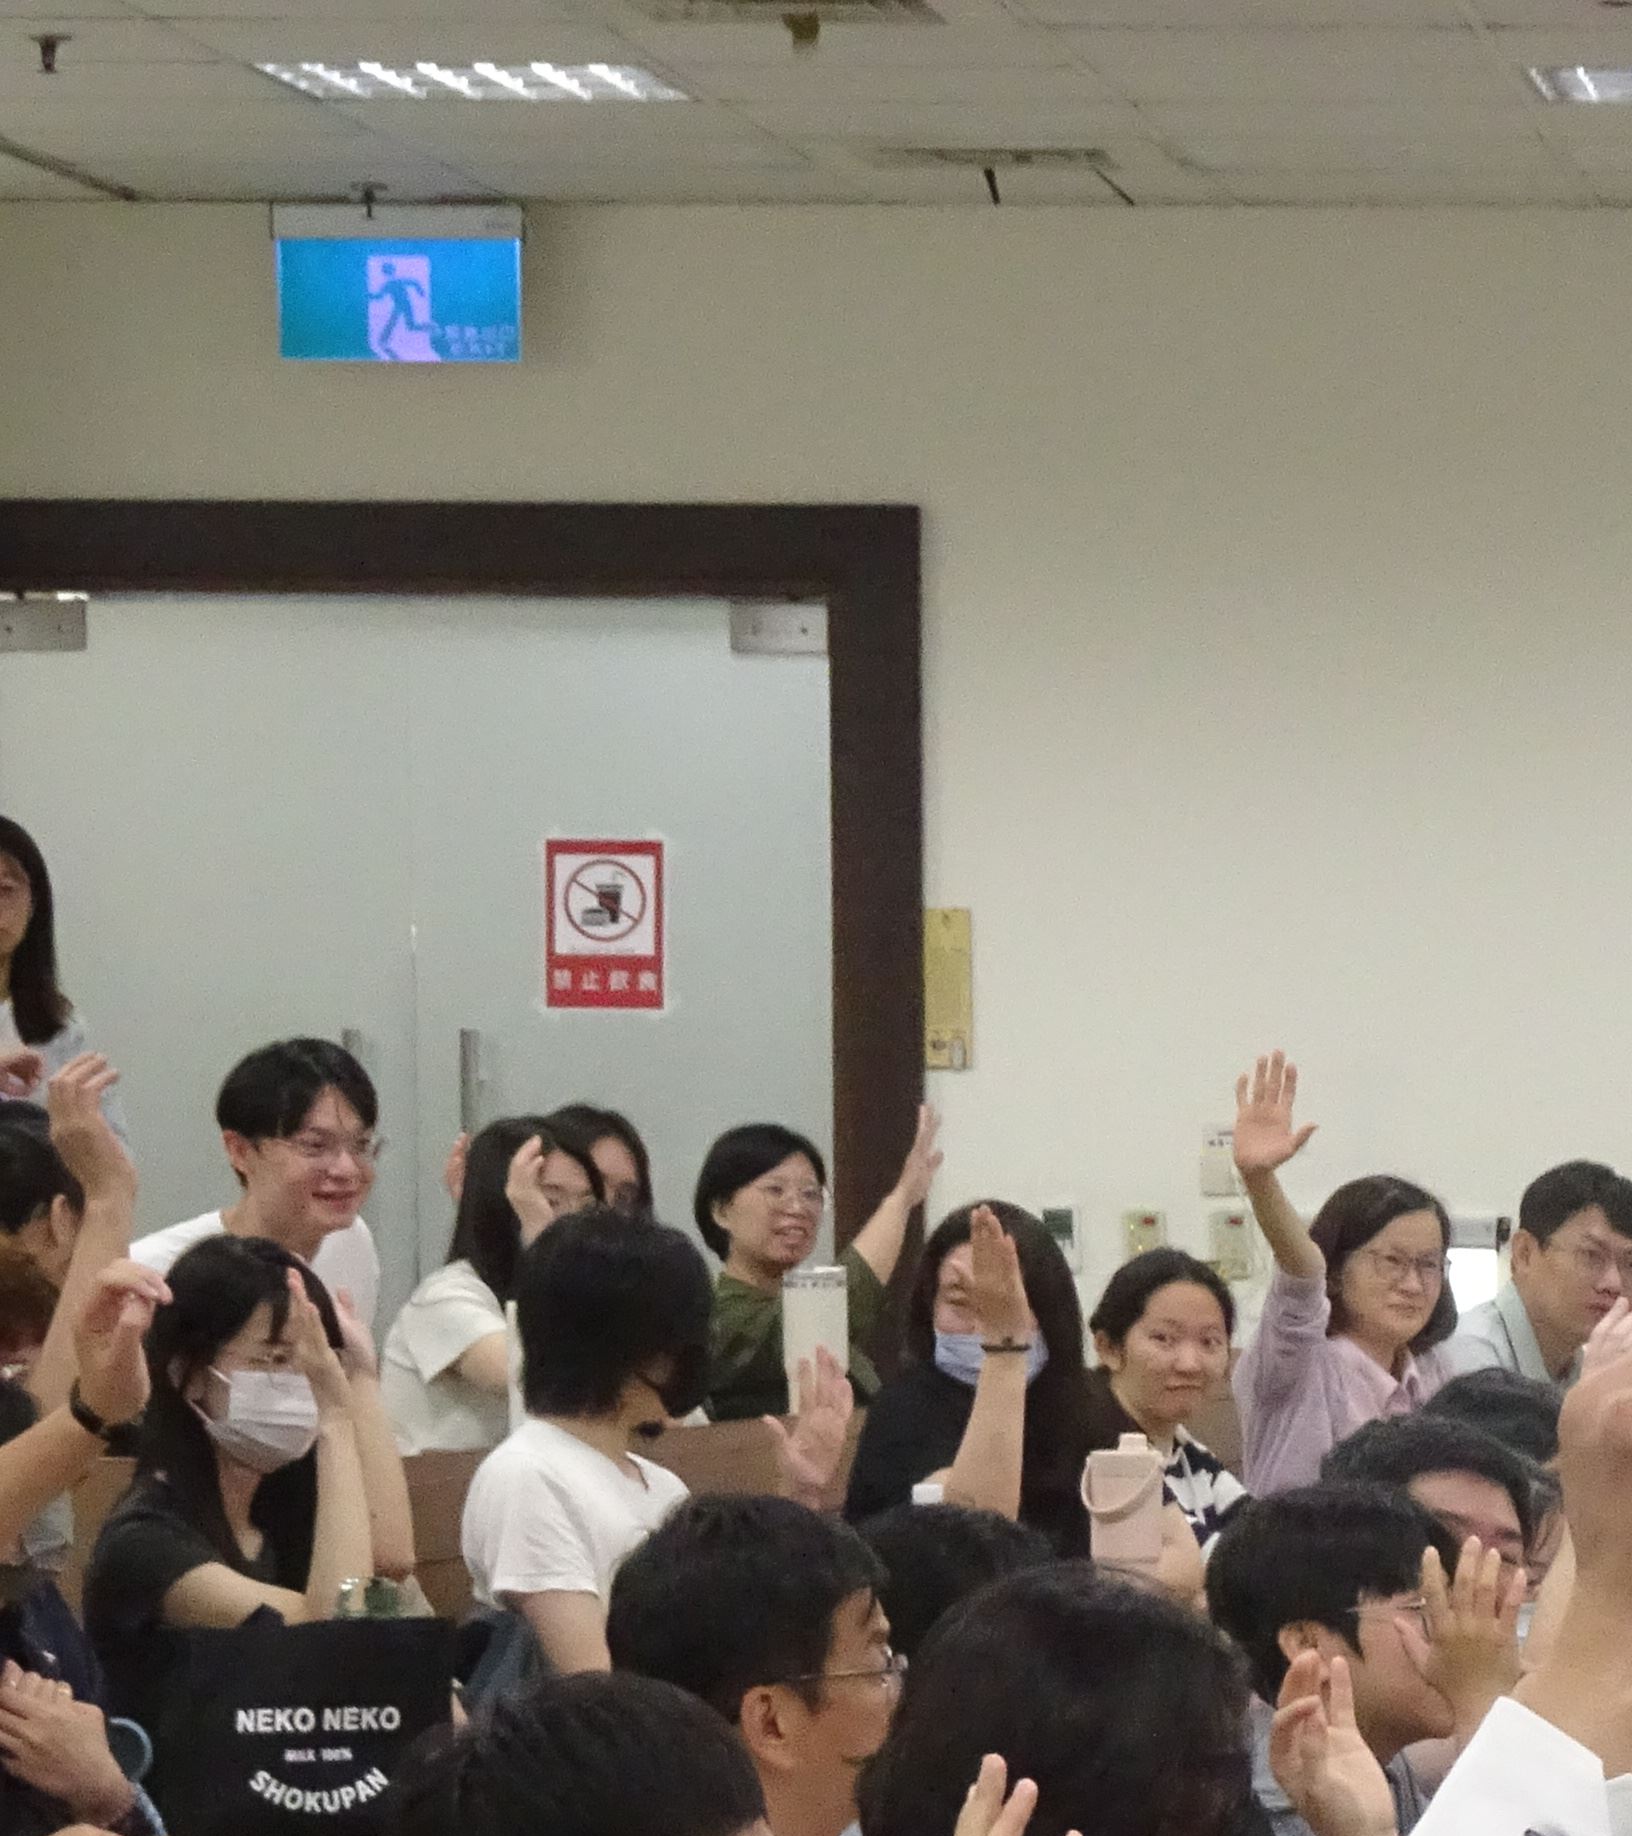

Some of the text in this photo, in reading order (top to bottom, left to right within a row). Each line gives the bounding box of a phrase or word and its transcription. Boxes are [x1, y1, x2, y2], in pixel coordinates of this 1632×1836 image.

[236, 1705, 401, 1733] NEKO NEKO
[249, 1766, 390, 1814] SHOKUPAN
